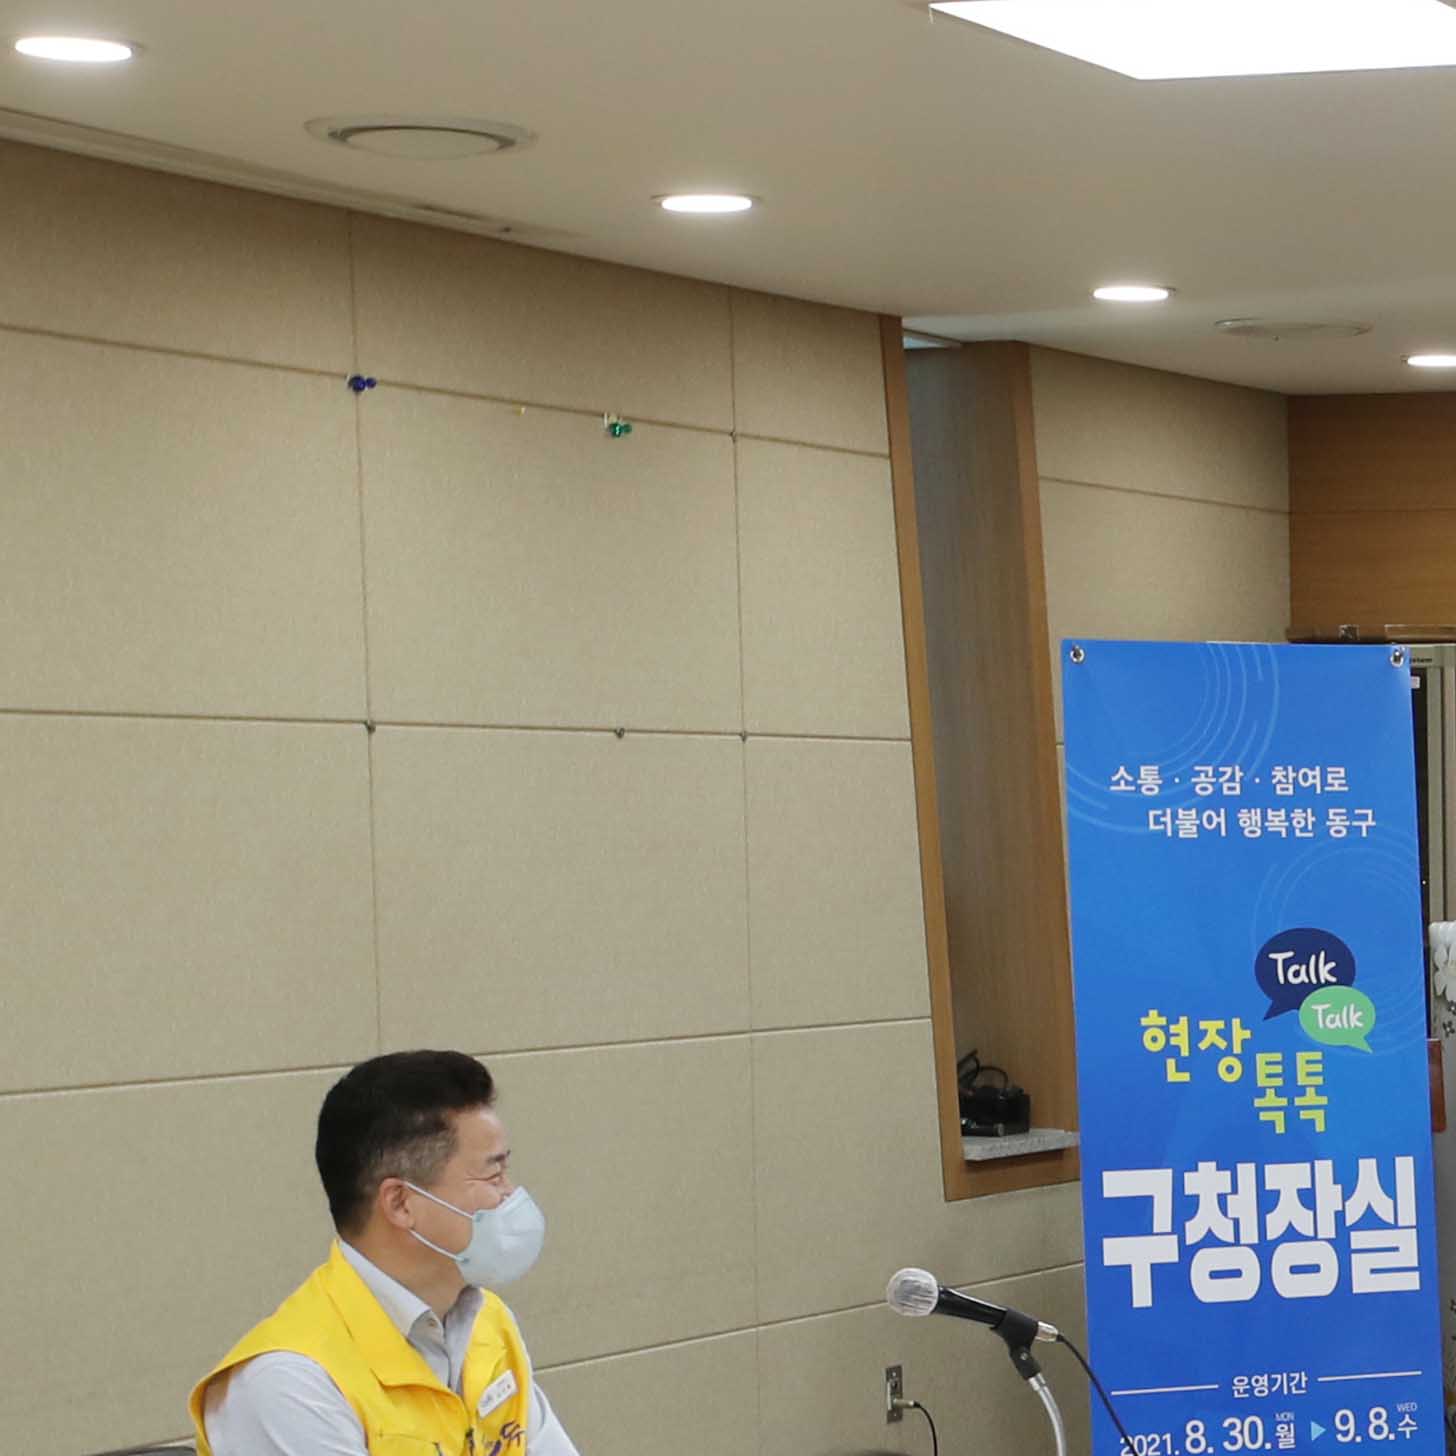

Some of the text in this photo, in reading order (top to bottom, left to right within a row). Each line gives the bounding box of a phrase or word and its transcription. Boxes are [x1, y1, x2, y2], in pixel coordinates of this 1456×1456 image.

[1109, 765, 1349, 796] 소통 공감 참여로
[1148, 808, 1376, 838] 더불어 행복한 동구
[1268, 950, 1337, 984] Talk
[1311, 1003, 1364, 1030] Talk
[1139, 1009, 1329, 1134] 현장 톡톡
[1102, 1156, 1421, 1308] 구청장실
[1231, 1371, 1309, 1399] 운영기간
[1397, 1402, 1417, 1412] WED
[1185, 1420, 1214, 1454] 8.
[1222, 1416, 1272, 1451] 30.
[1275, 1423, 1296, 1449] 월
[1334, 1407, 1396, 1443] 9. 8.
[1397, 1414, 1419, 1439] 수
